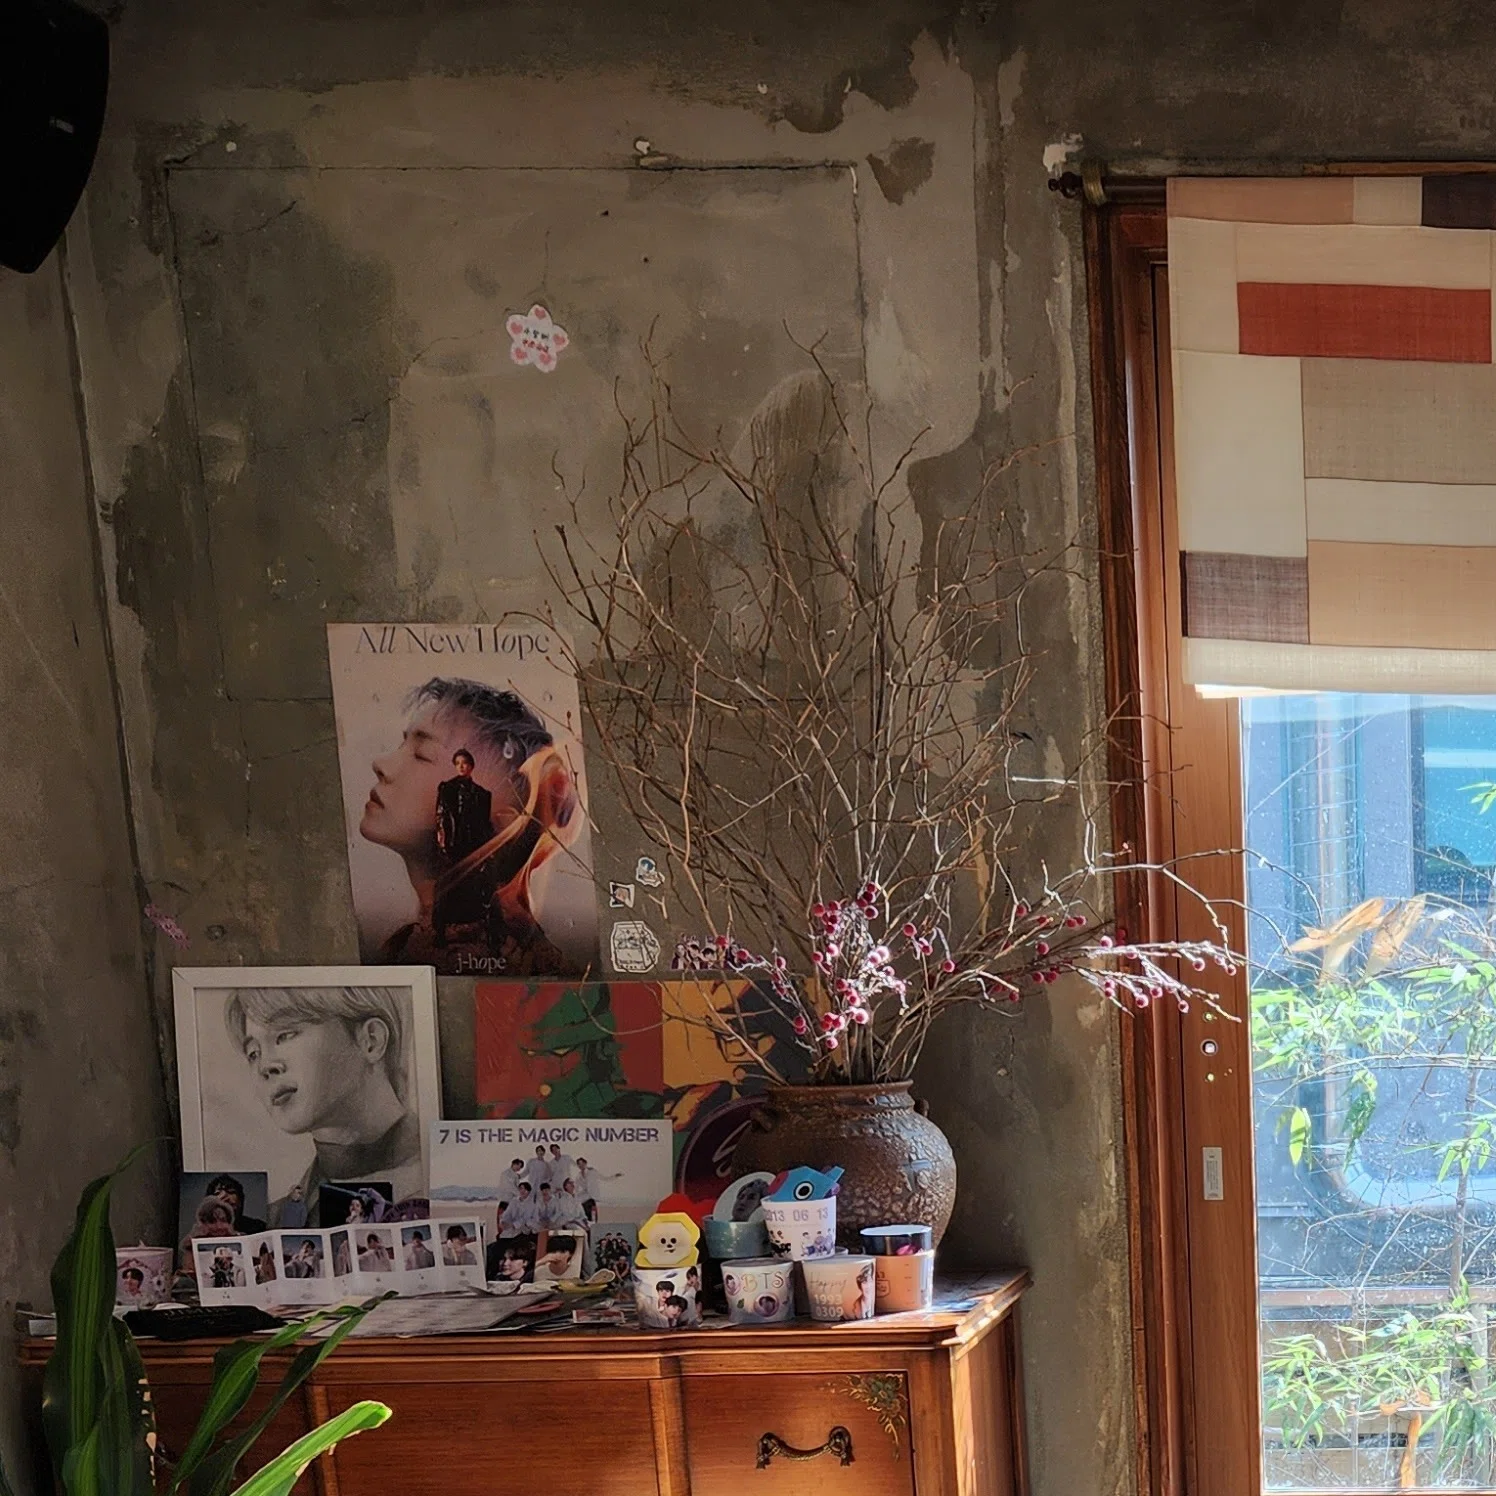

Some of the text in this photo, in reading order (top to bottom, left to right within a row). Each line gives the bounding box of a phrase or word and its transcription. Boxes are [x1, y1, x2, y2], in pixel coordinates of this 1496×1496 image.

[356, 626, 550, 661] All New Hope
[455, 952, 507, 974] j-hope
[439, 1127, 660, 1145] 7 IS THE MAGIC NUMBER
[793, 1208, 809, 1222] 06
[817, 1206, 829, 1220] 13
[741, 1271, 784, 1293] BTS
[815, 1306, 844, 1318] 0309
